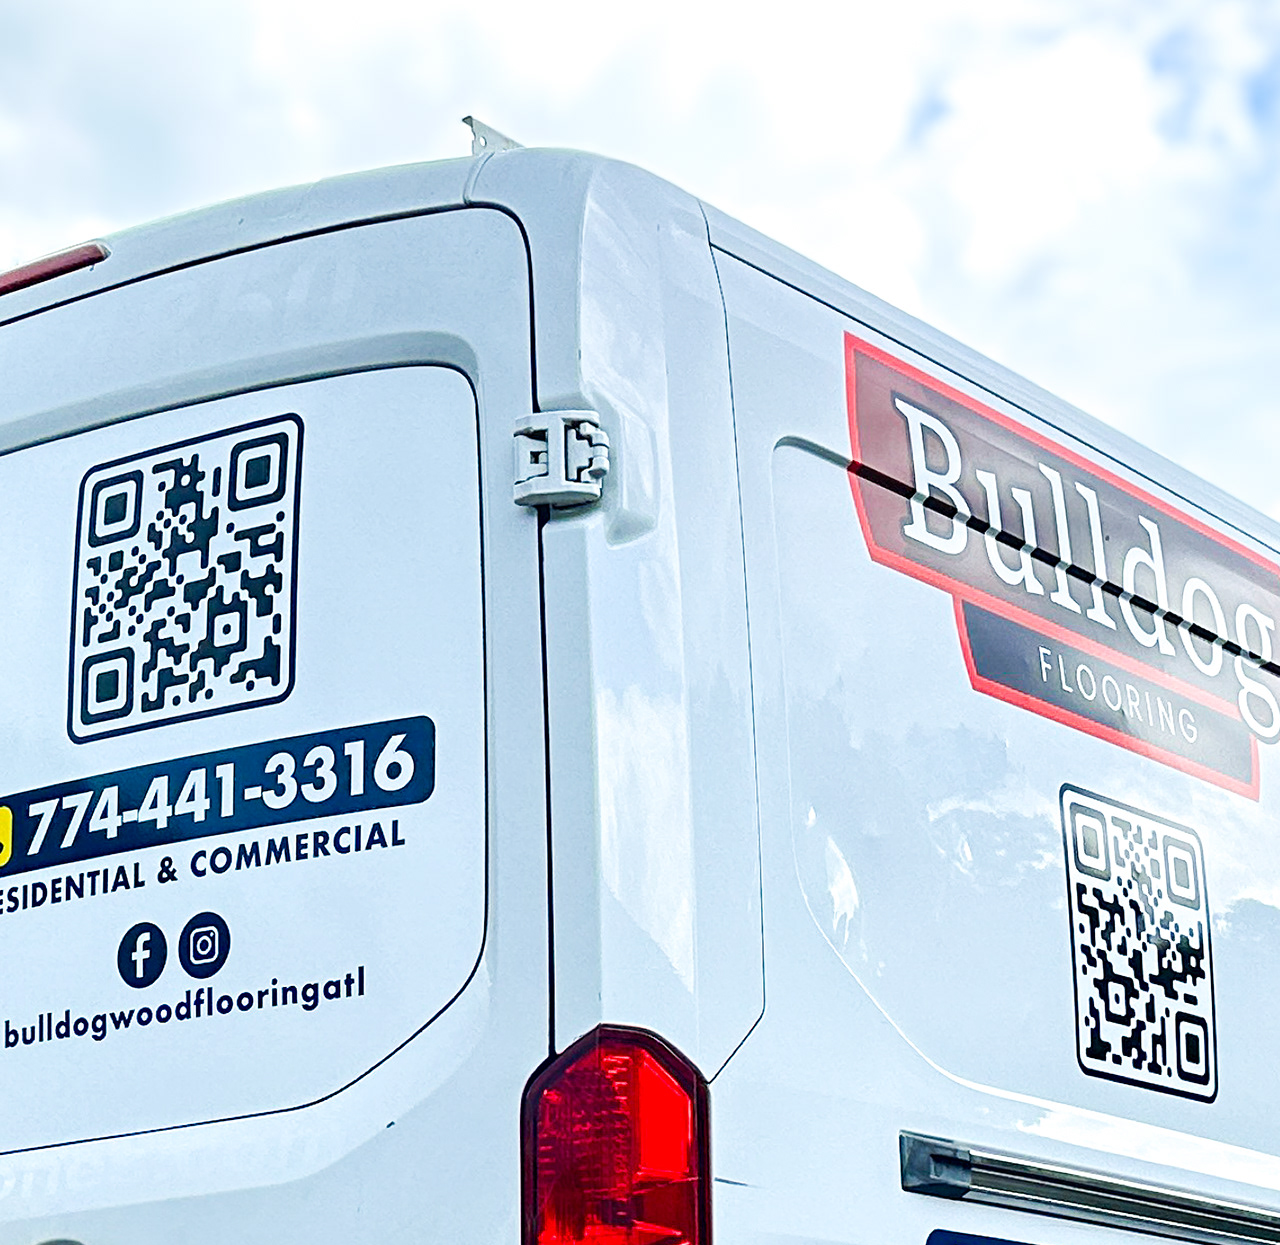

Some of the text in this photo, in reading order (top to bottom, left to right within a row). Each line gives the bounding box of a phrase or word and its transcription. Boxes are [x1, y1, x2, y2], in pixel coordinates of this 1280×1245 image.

[1037, 646, 1198, 744] FLOORING
[26, 733, 415, 857] 774-441-3316
[157, 856, 178, 883] &
[190, 819, 406, 878] COMMERCIAL
[4, 966, 366, 1049] bulldogwoodflooringatl
